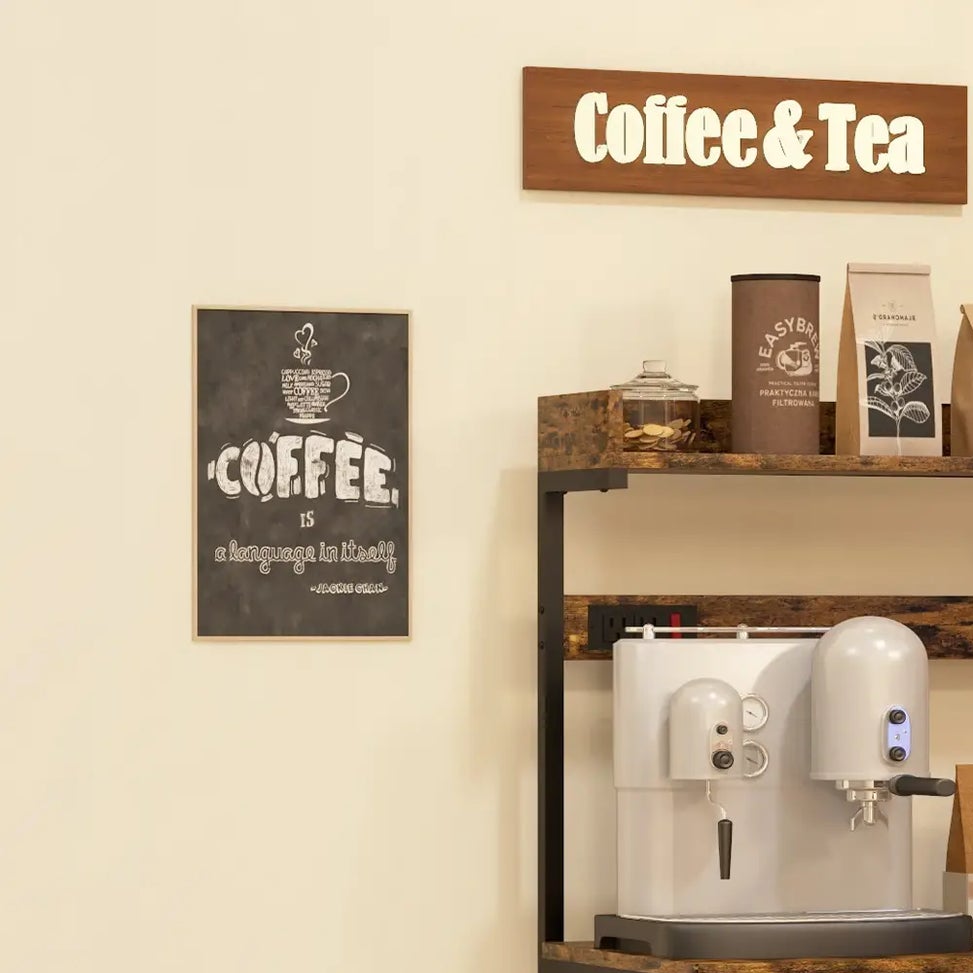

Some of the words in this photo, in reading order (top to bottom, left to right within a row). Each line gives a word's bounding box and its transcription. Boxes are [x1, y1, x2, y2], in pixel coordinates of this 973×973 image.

[574, 91, 758, 168] Coffee
[762, 99, 814, 170] &
[818, 102, 926, 175] Tea
[294, 386, 319, 396] COFFEE
[300, 511, 315, 528] IS
[214, 545, 227, 562] a
[228, 539, 317, 574] language
[319, 541, 338, 562] in
[340, 539, 397, 574] itself
